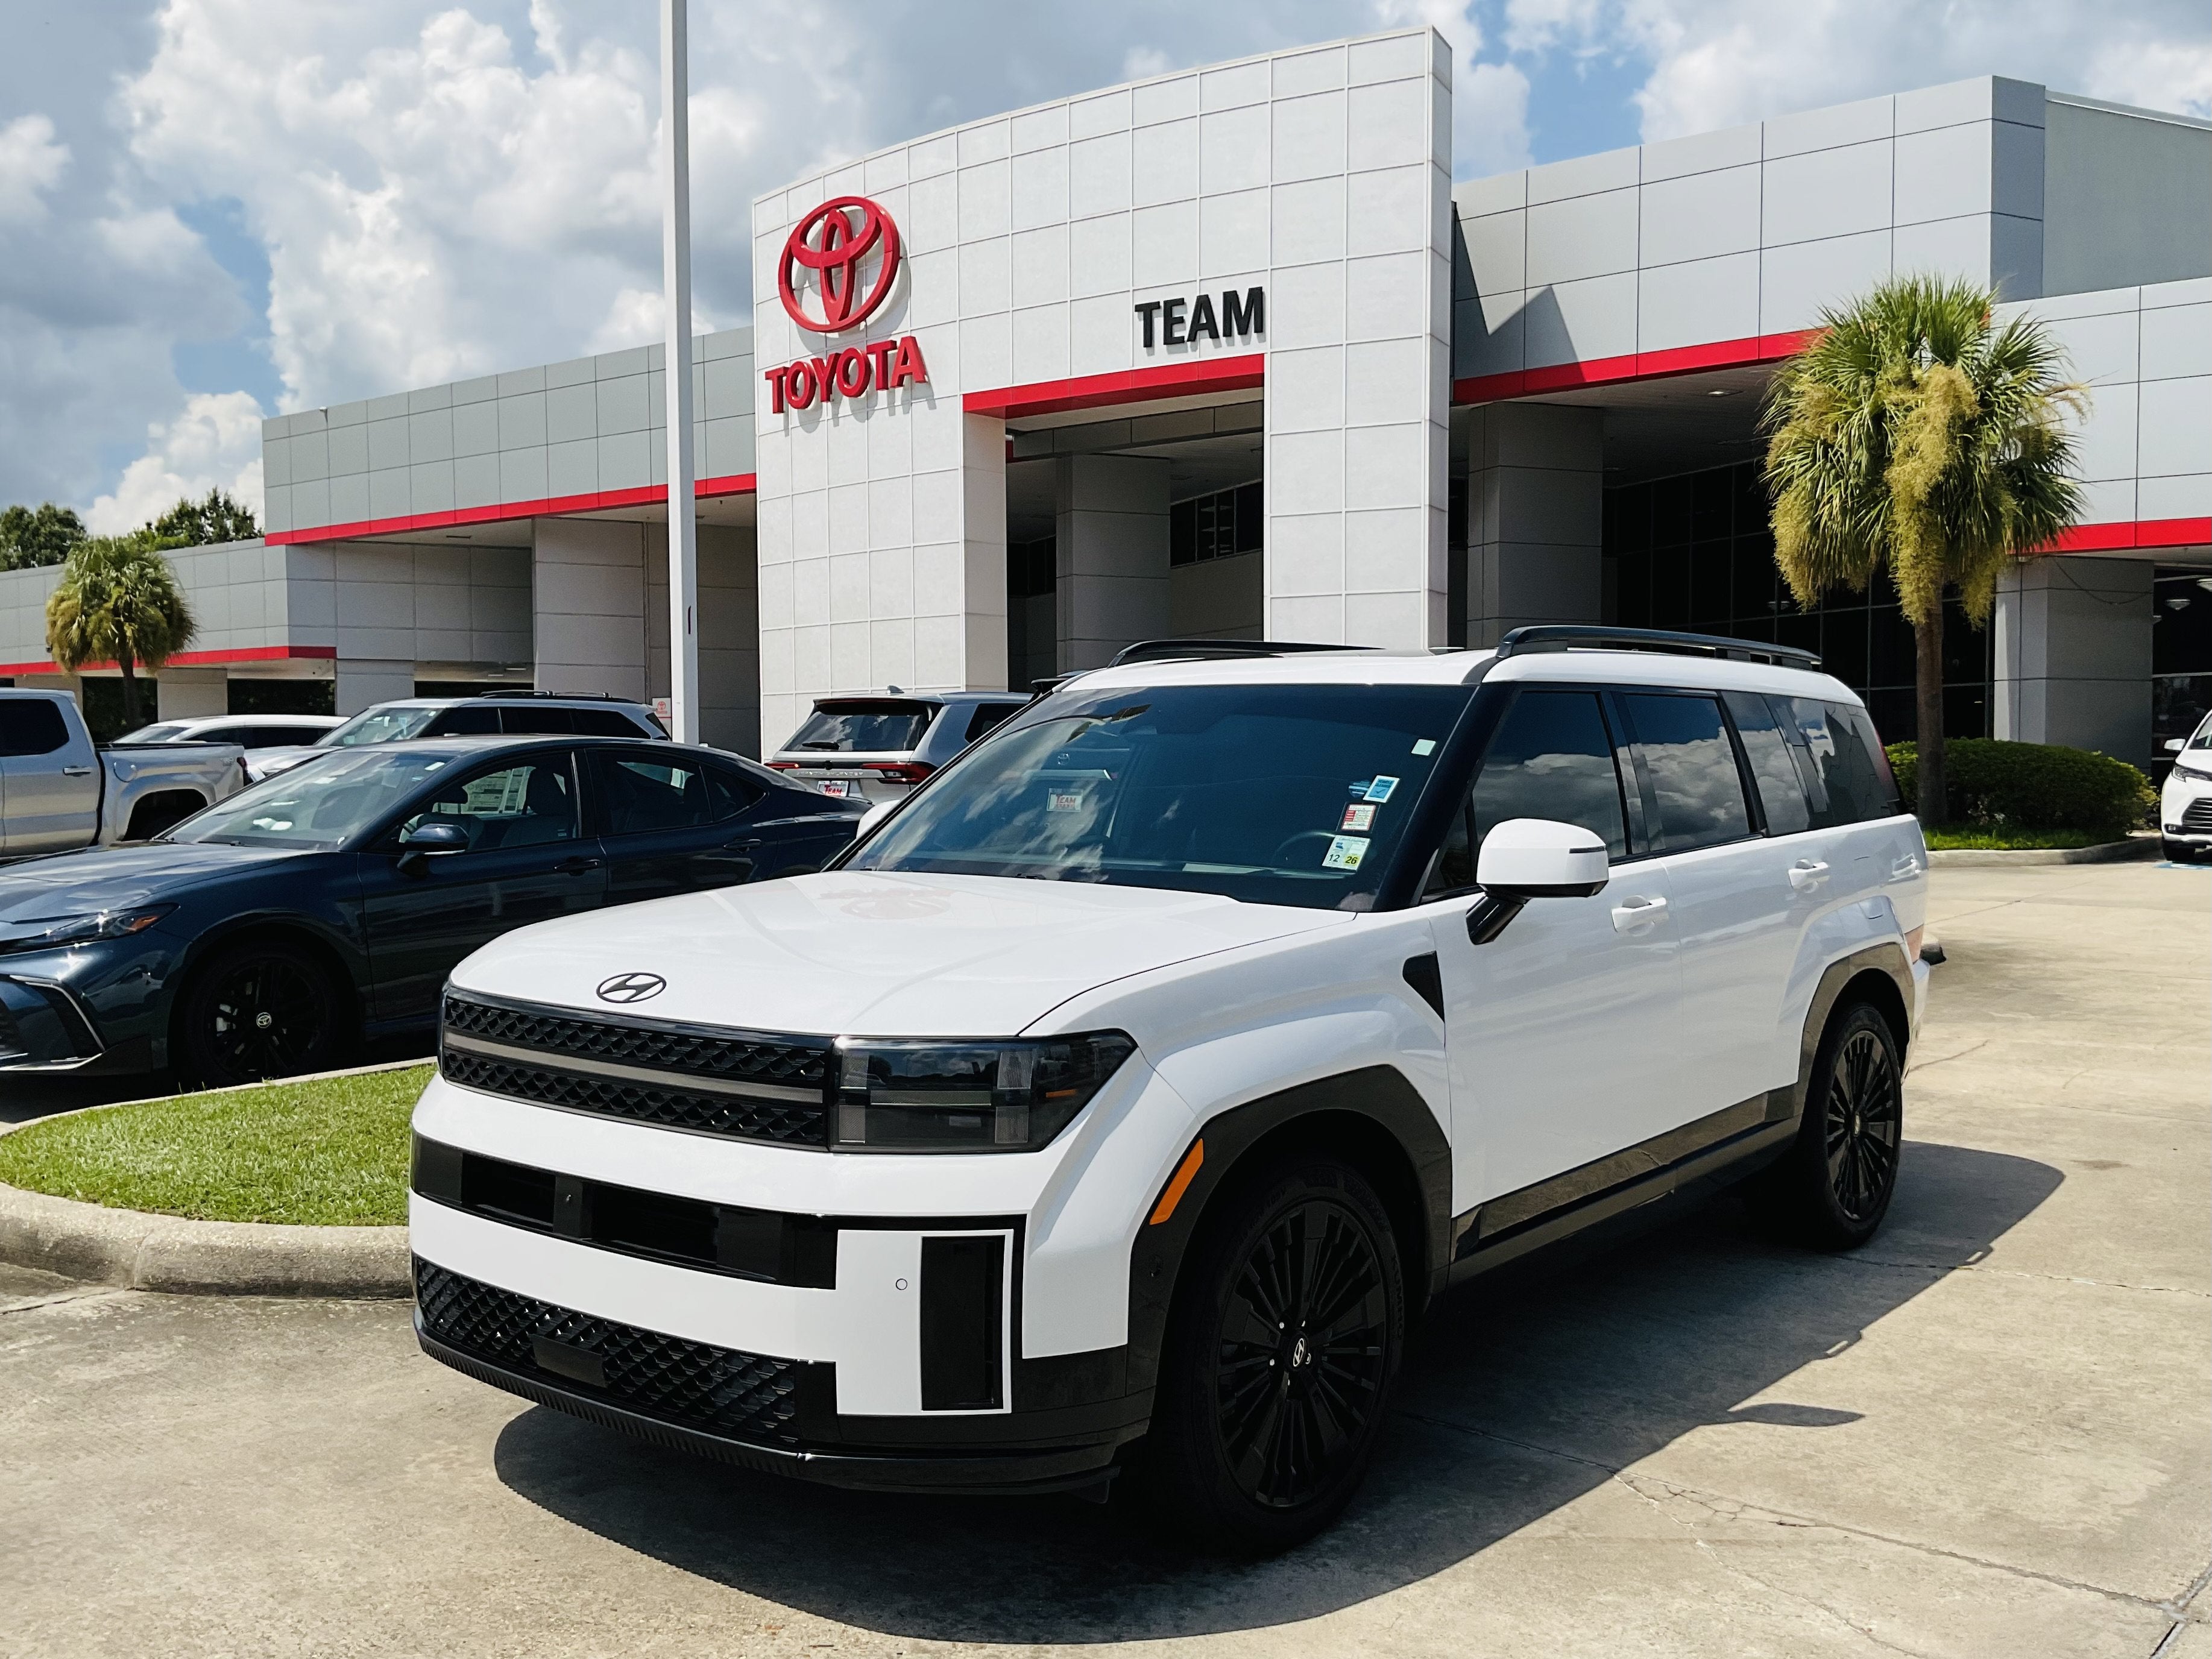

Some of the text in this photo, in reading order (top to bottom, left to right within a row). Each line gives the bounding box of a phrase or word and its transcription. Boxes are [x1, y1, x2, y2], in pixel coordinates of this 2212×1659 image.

[1134, 286, 1264, 348] TEAM
[764, 335, 928, 414] TOYOTA
[824, 784, 842, 795] TEAM
[1056, 794, 1076, 804] TEAM
[1329, 854, 1340, 862] 12
[1345, 856, 1358, 864] 26
